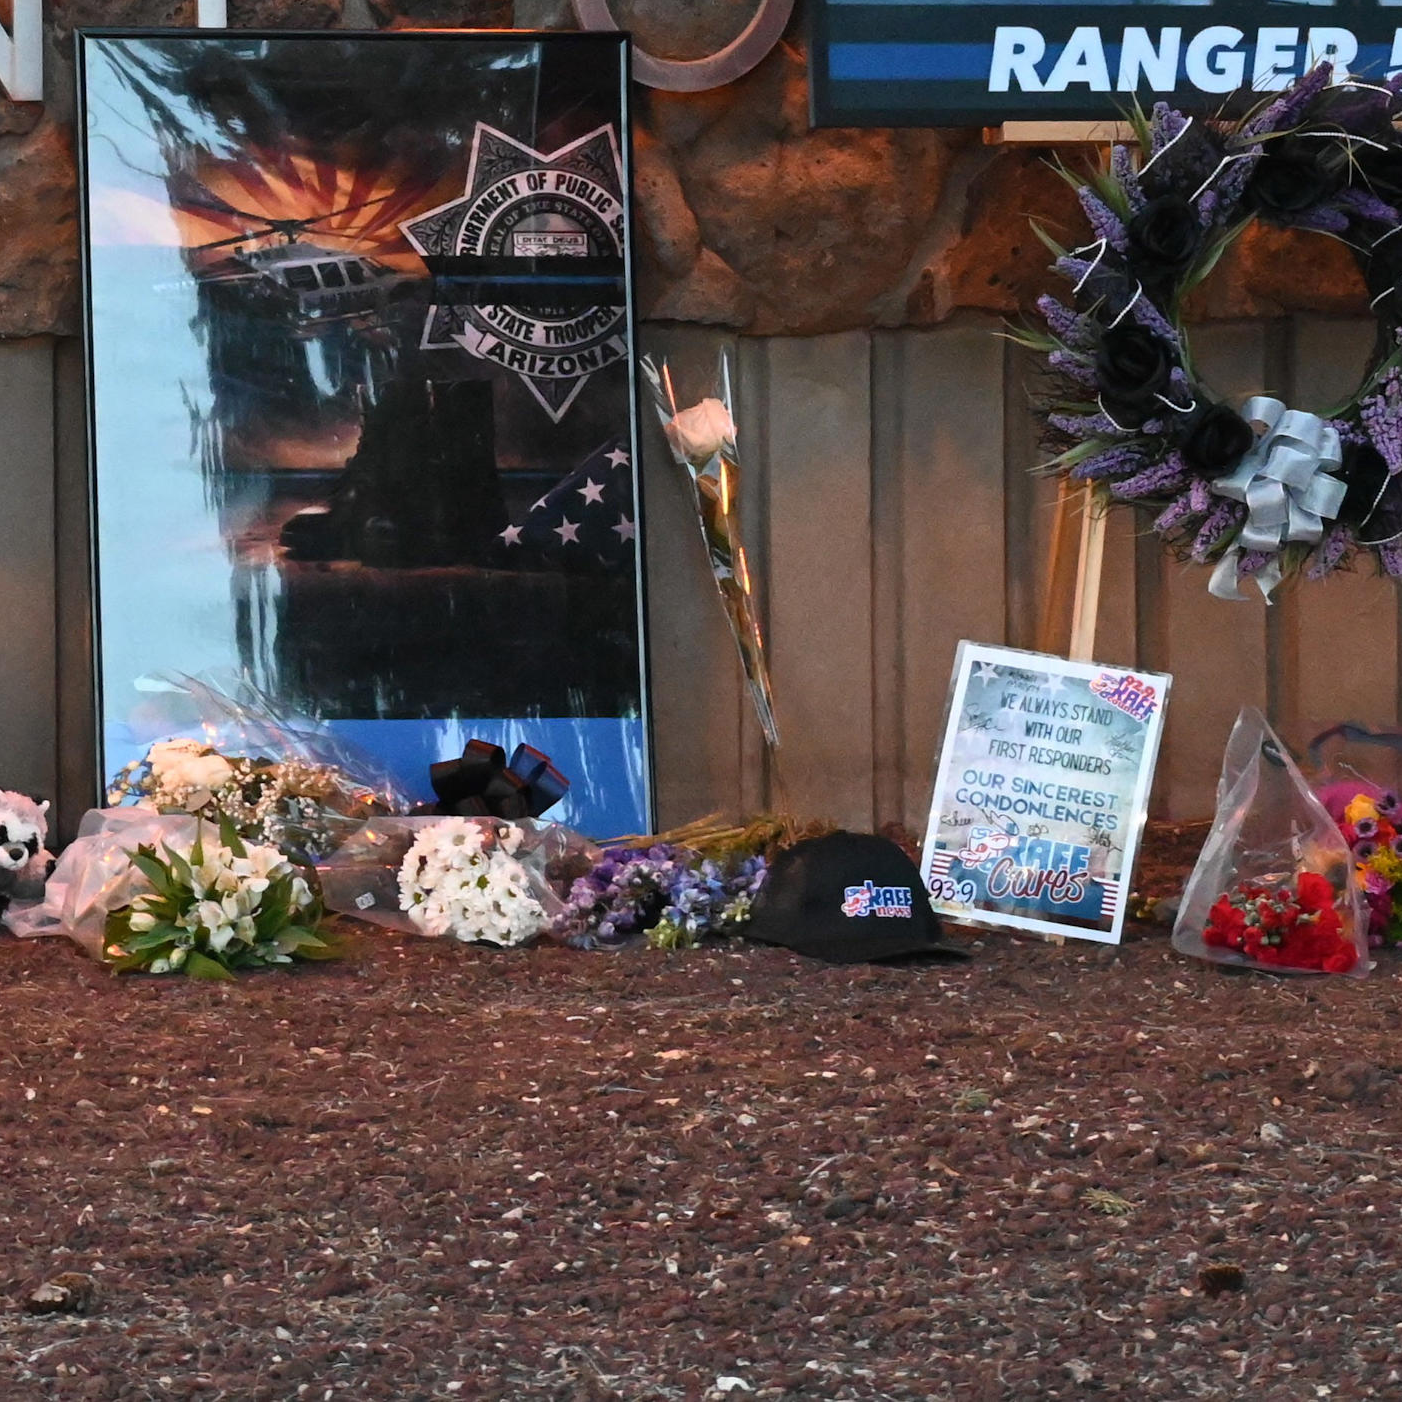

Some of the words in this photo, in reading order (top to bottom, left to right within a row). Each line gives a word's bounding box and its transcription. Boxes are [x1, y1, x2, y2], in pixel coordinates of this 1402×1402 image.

[988, 25, 1359, 94] RANGER
[526, 172, 548, 191] OF
[555, 172, 613, 214] PUBLIC
[488, 304, 536, 341] STATE
[485, 341, 620, 375] ARIZONA
[1000, 693, 1015, 710] WE
[1019, 694, 1069, 719] ALWAYS
[1070, 703, 1114, 727] STAND
[1025, 720, 1052, 740] WITH
[1055, 726, 1083, 745] OUR
[988, 739, 1026, 760] FIRST
[1028, 745, 1112, 776] RESPONDERS
[956, 787, 1119, 830] CONDONLENCES
[962, 769, 1006, 789] OUR
[1011, 776, 1119, 810] SINCEREST
[996, 826, 1091, 875] KAFF
[986, 856, 1089, 904] Cares
[877, 906, 912, 917] news
